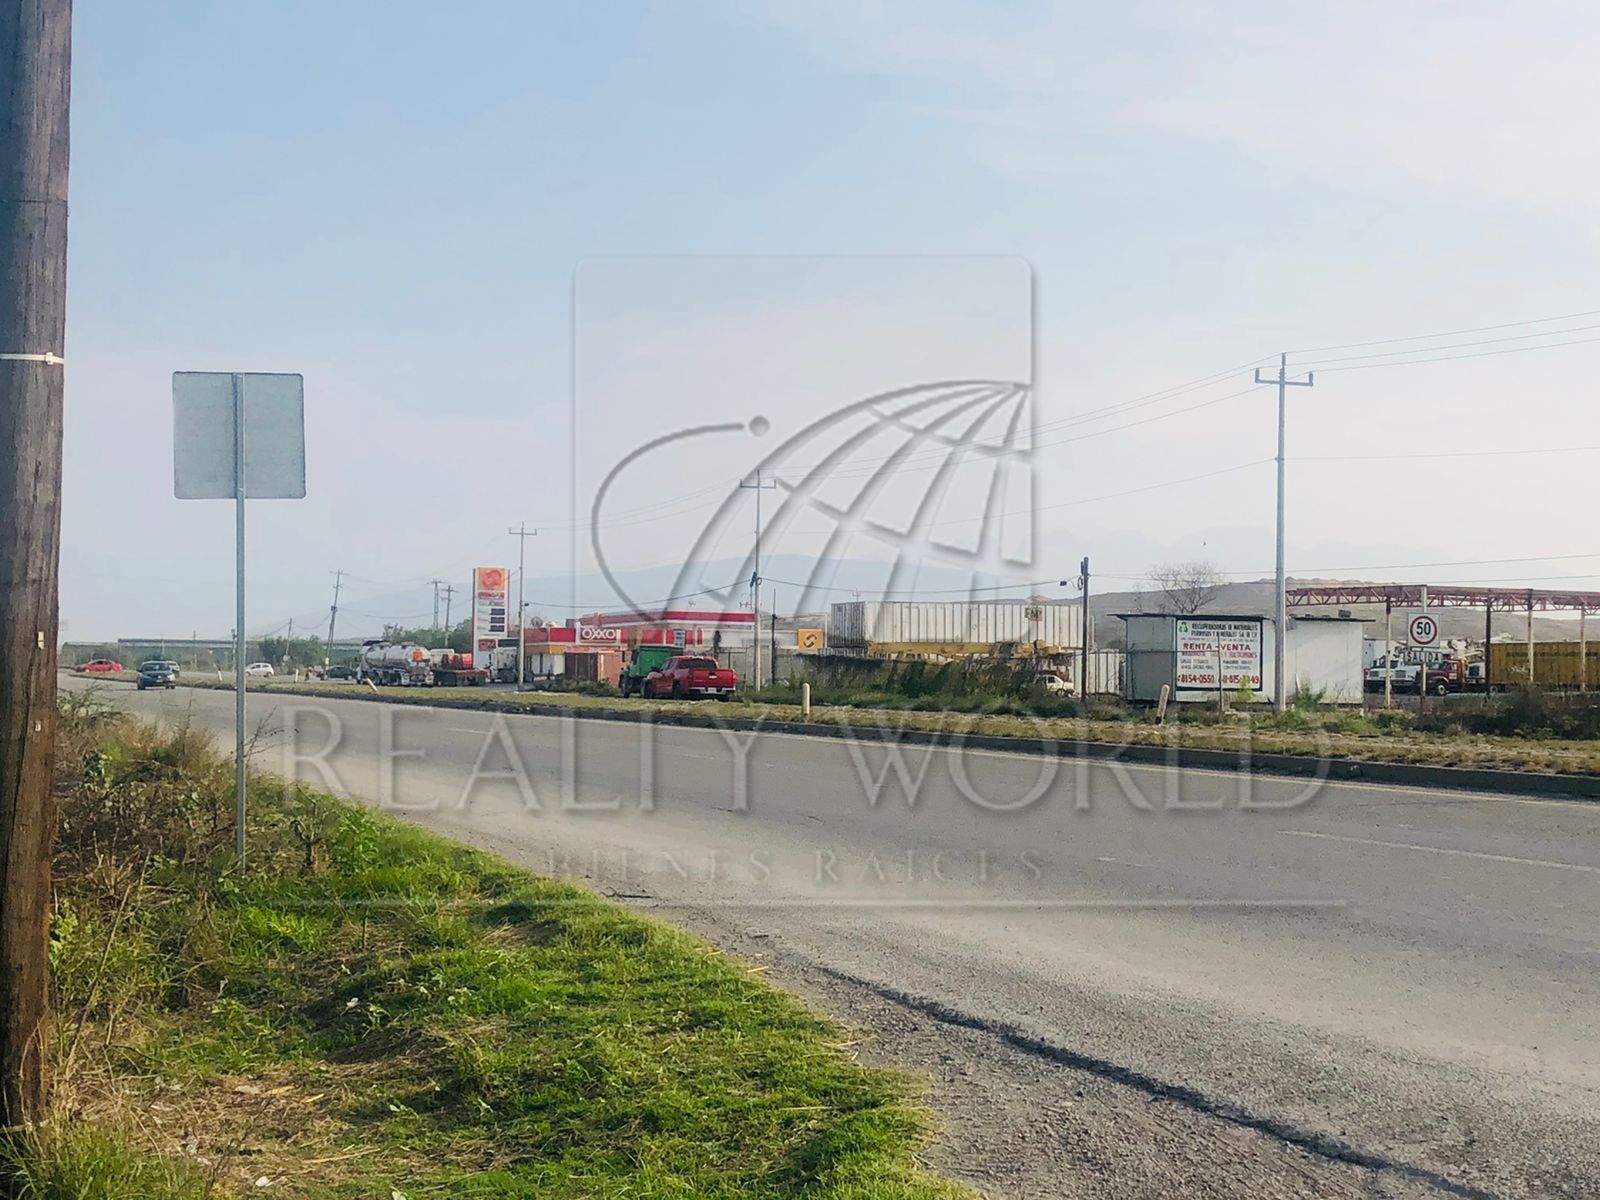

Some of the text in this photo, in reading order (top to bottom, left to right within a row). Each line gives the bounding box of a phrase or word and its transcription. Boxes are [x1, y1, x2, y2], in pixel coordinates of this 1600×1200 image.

[581, 628, 616, 641] OXXO
[1416, 622, 1431, 635] 50
[1183, 643, 1212, 651] RENTA
[1220, 643, 1251, 651] VENTA
[1407, 651, 1439, 663] SALIDA
